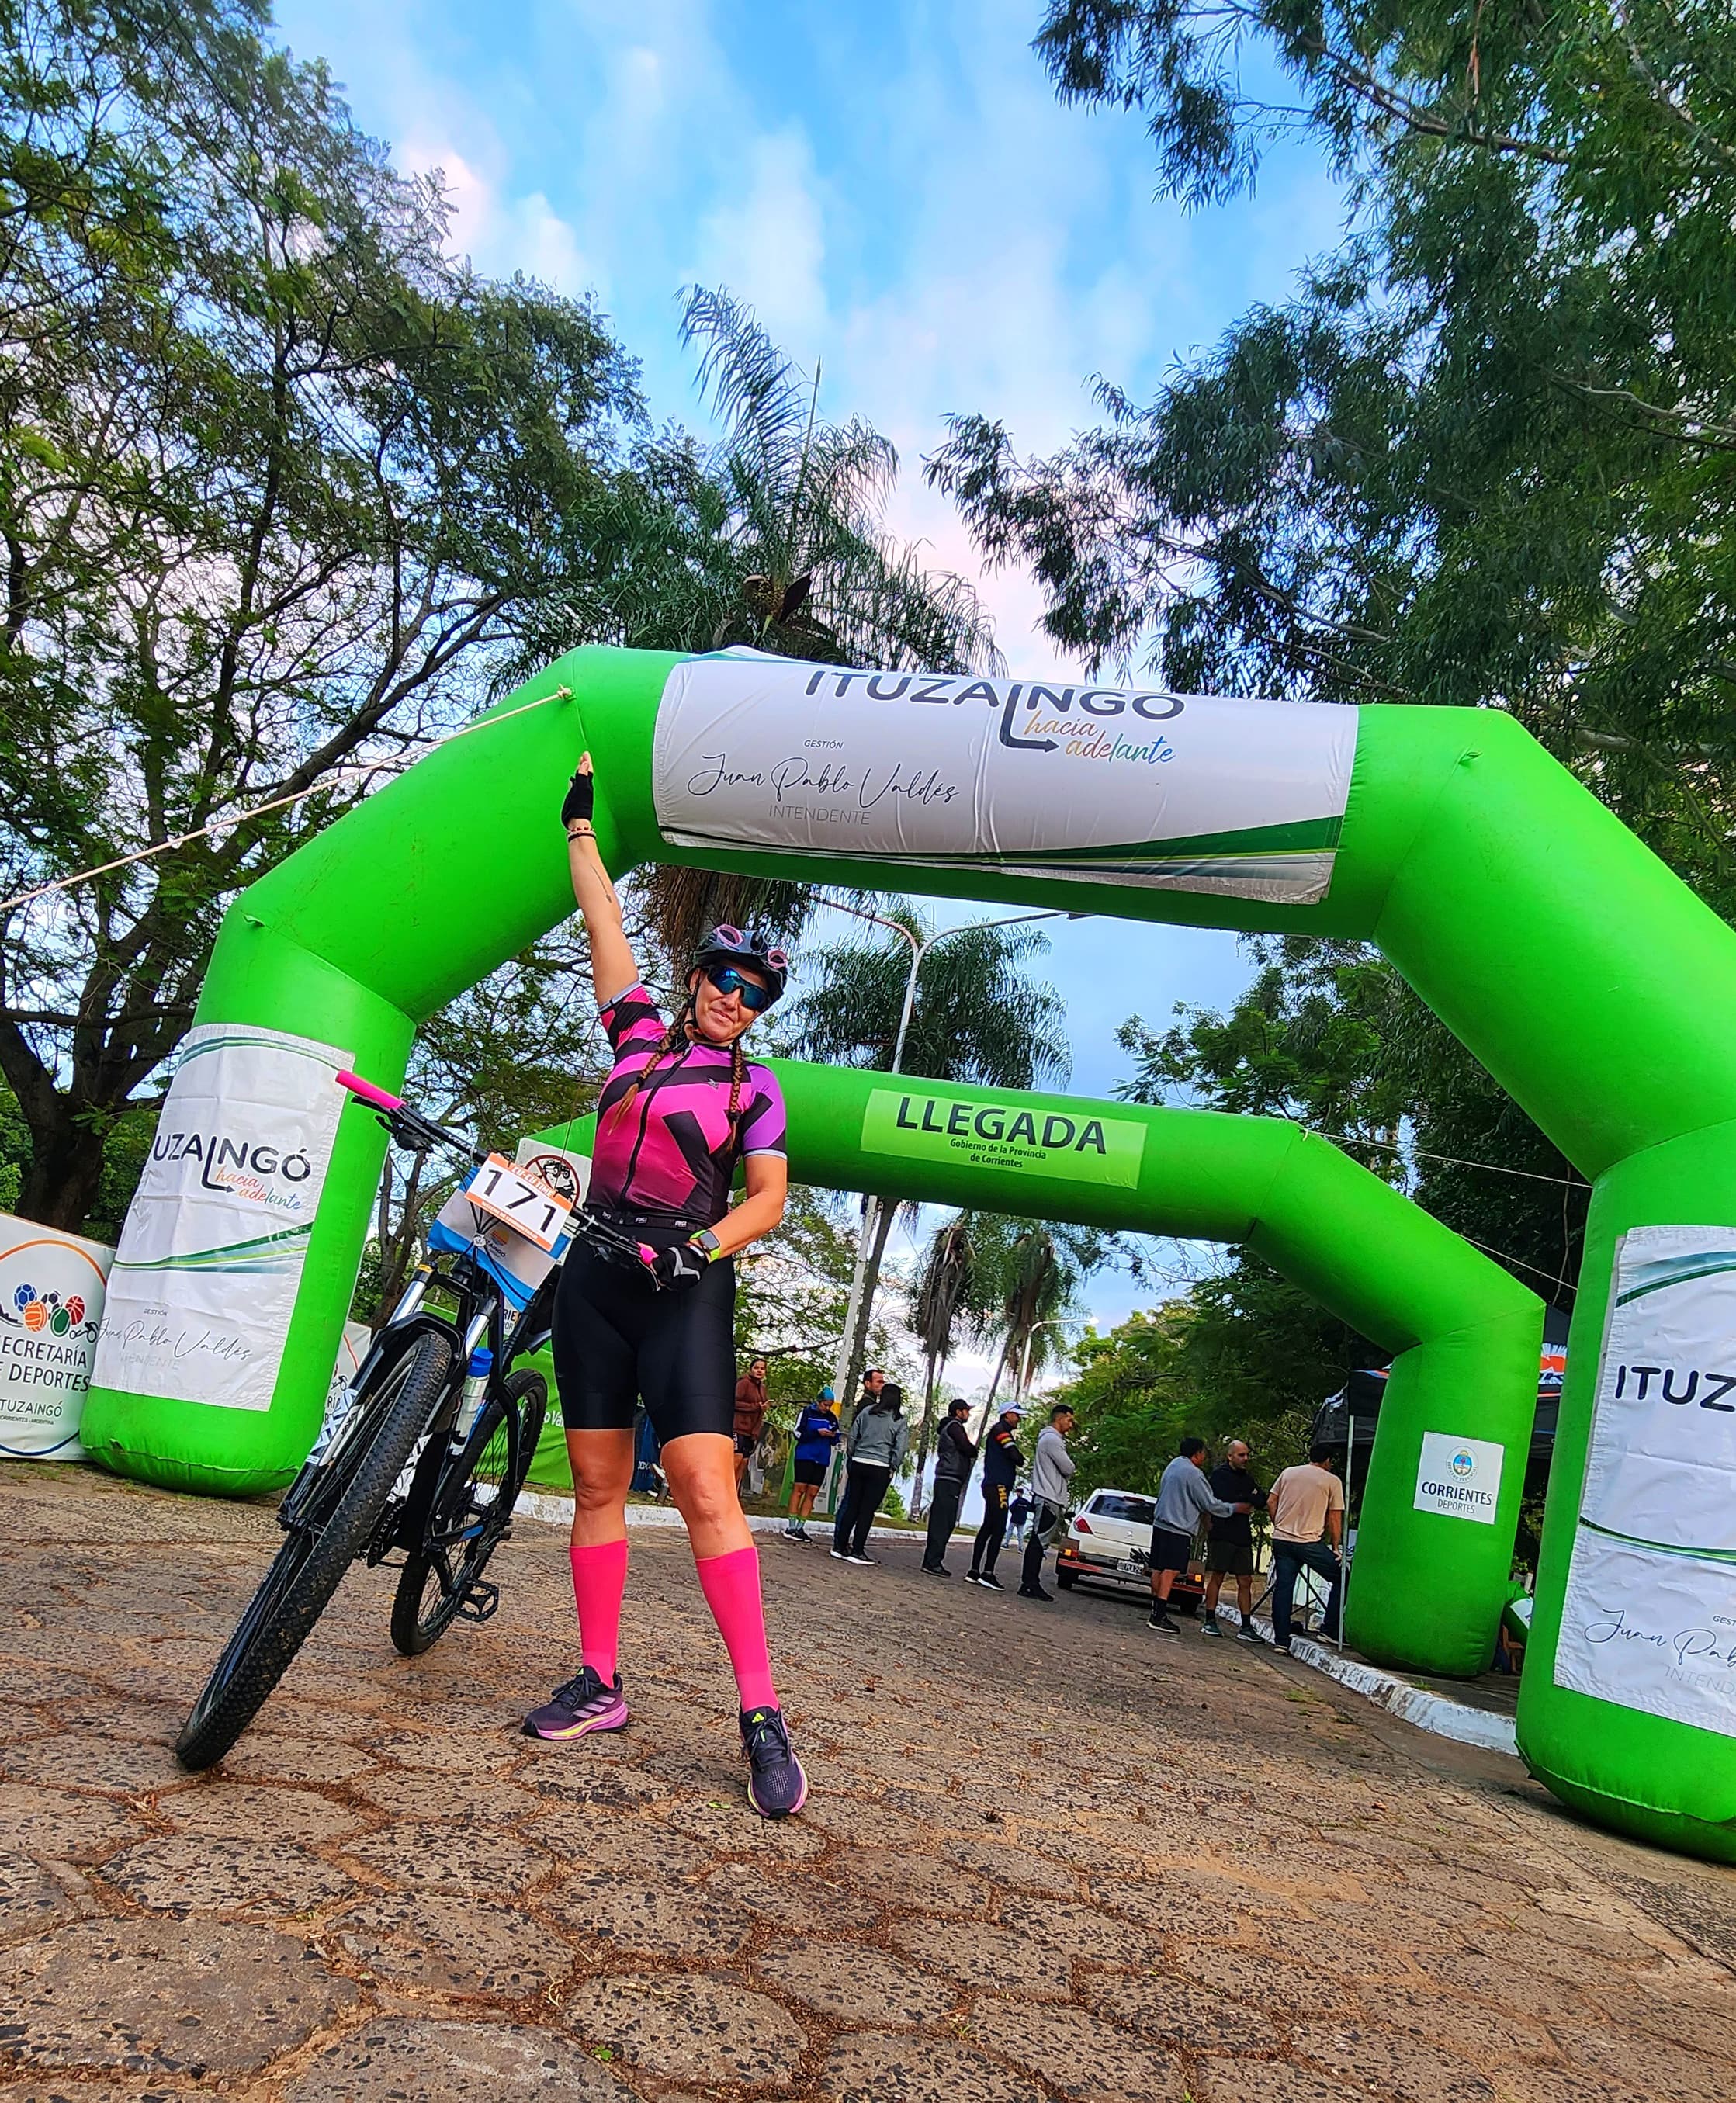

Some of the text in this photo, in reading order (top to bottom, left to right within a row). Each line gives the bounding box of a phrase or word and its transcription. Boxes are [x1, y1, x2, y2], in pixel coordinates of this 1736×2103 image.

[1024, 709, 1099, 736] hacia
[803, 738, 844, 750] GESTIÓN
[1065, 728, 1176, 765] adelante
[688, 753, 960, 809] Juan Pablo Valdés
[768, 803, 871, 826] INTENDENTE
[896, 1097, 1107, 1155] LLEGADA
[950, 1138, 1047, 1160] Gobierno de la Provincia
[970, 1153, 1024, 1169] de Corrientes
[215, 1165, 260, 1188] hacia
[238, 1184, 302, 1211] adelante
[483, 1168, 557, 1234] 171
[2, 1336, 88, 1369] ECRETARÍA
[122, 1320, 172, 1349] Pablo
[174, 1330, 254, 1360] Valdés
[9, 1363, 91, 1393] DEPORTES
[1614, 1364, 1736, 1412] ITUZ
[1422, 1481, 1493, 1506] CORRIENTES
[1437, 1498, 1475, 1514] DEPORTES
[1584, 1608, 1668, 1647] Juan
